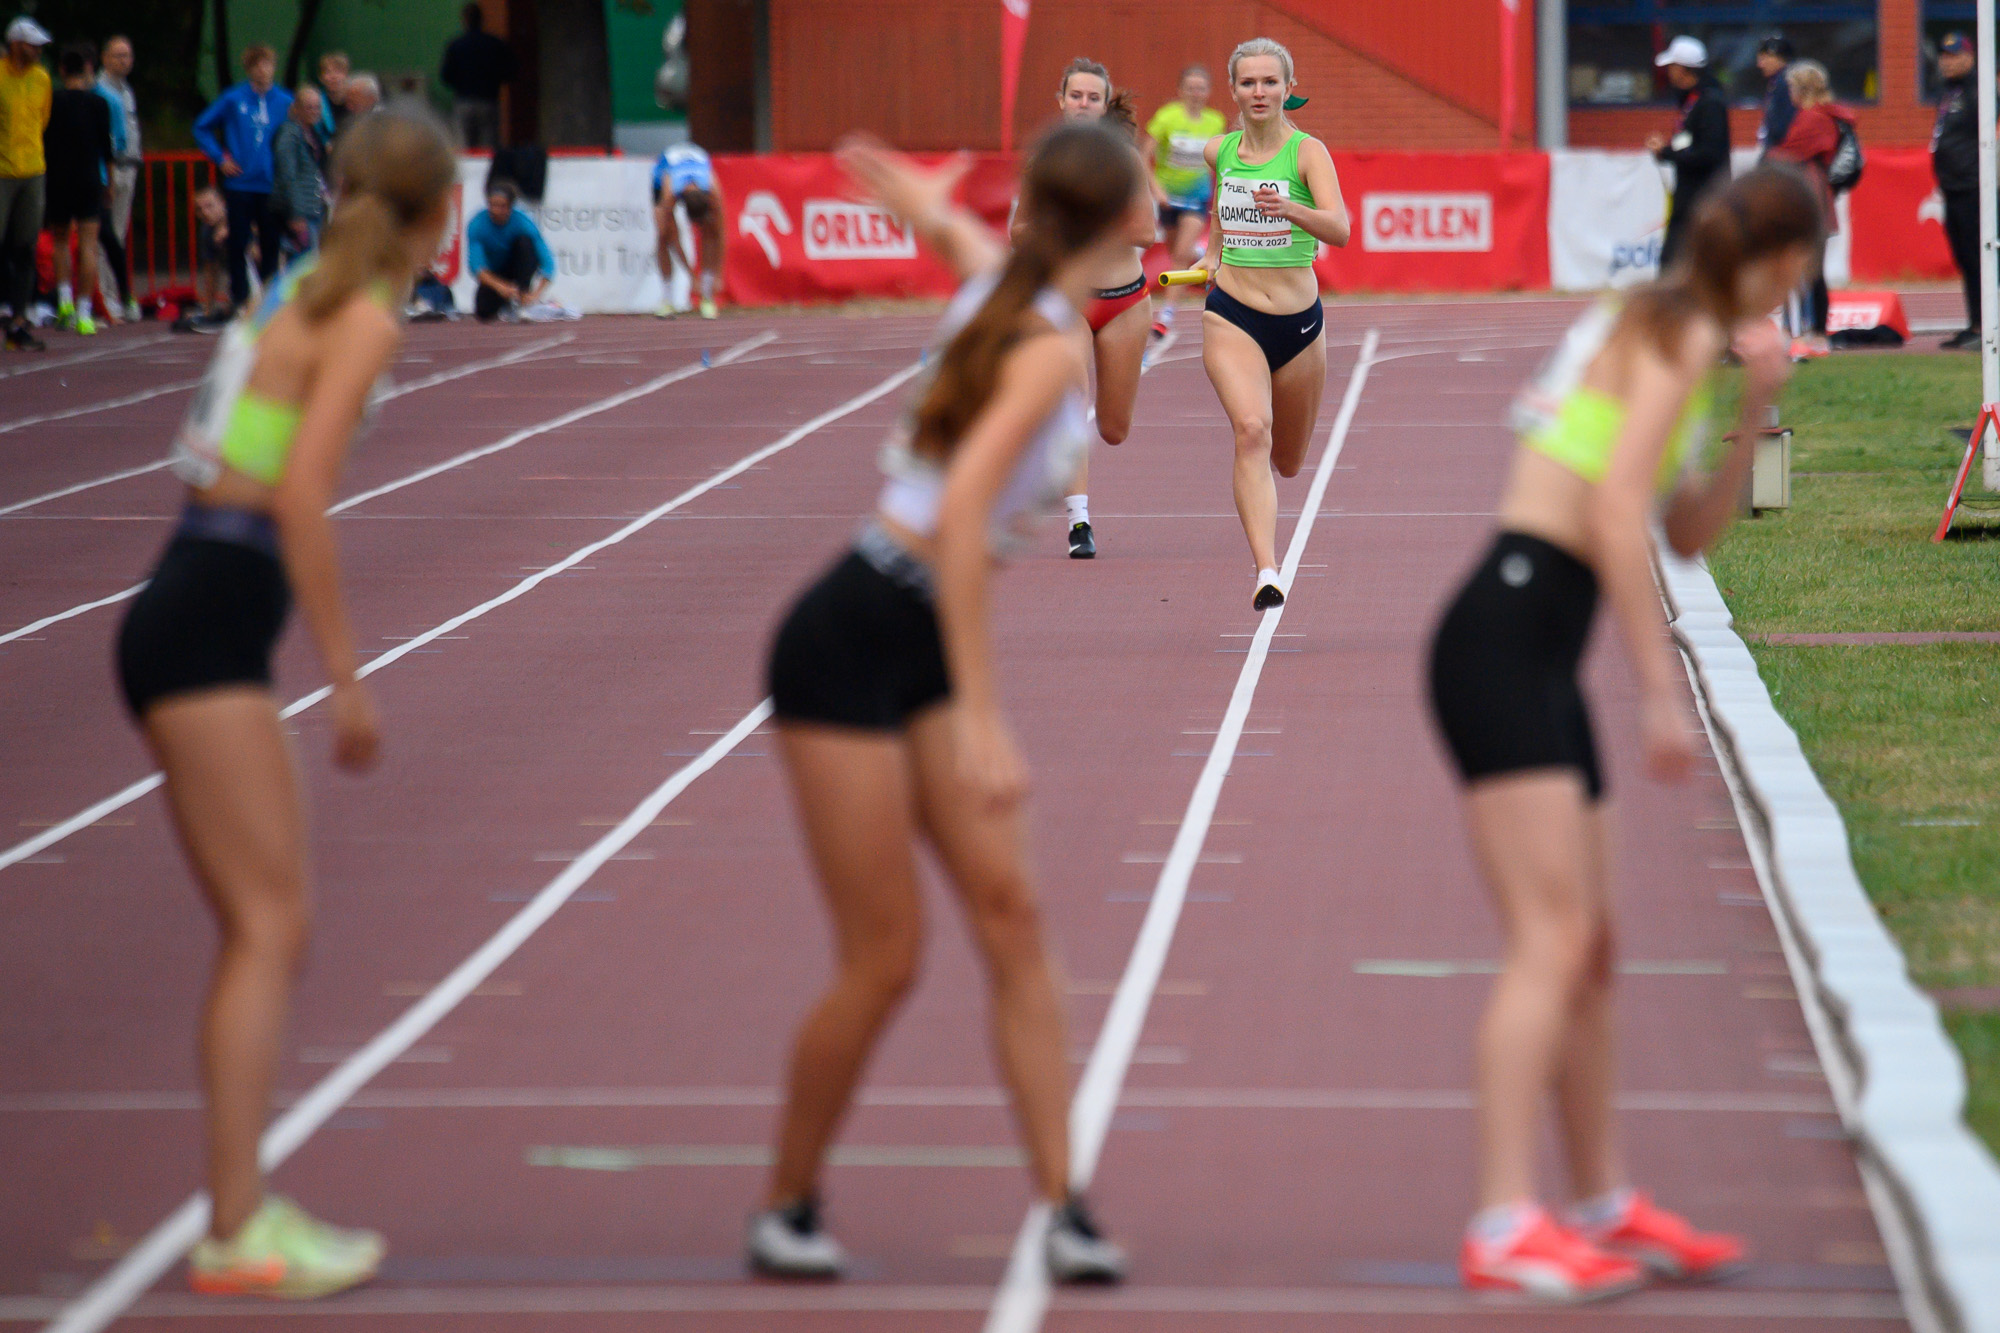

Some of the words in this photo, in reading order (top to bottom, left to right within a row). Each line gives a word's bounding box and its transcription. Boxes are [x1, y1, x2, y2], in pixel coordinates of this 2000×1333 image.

[811, 212, 906, 246] ORLEN
[1374, 206, 1480, 240] ORLEN
[1224, 237, 1263, 247] IAŁYSTOK
[1265, 237, 1288, 247] 2022
